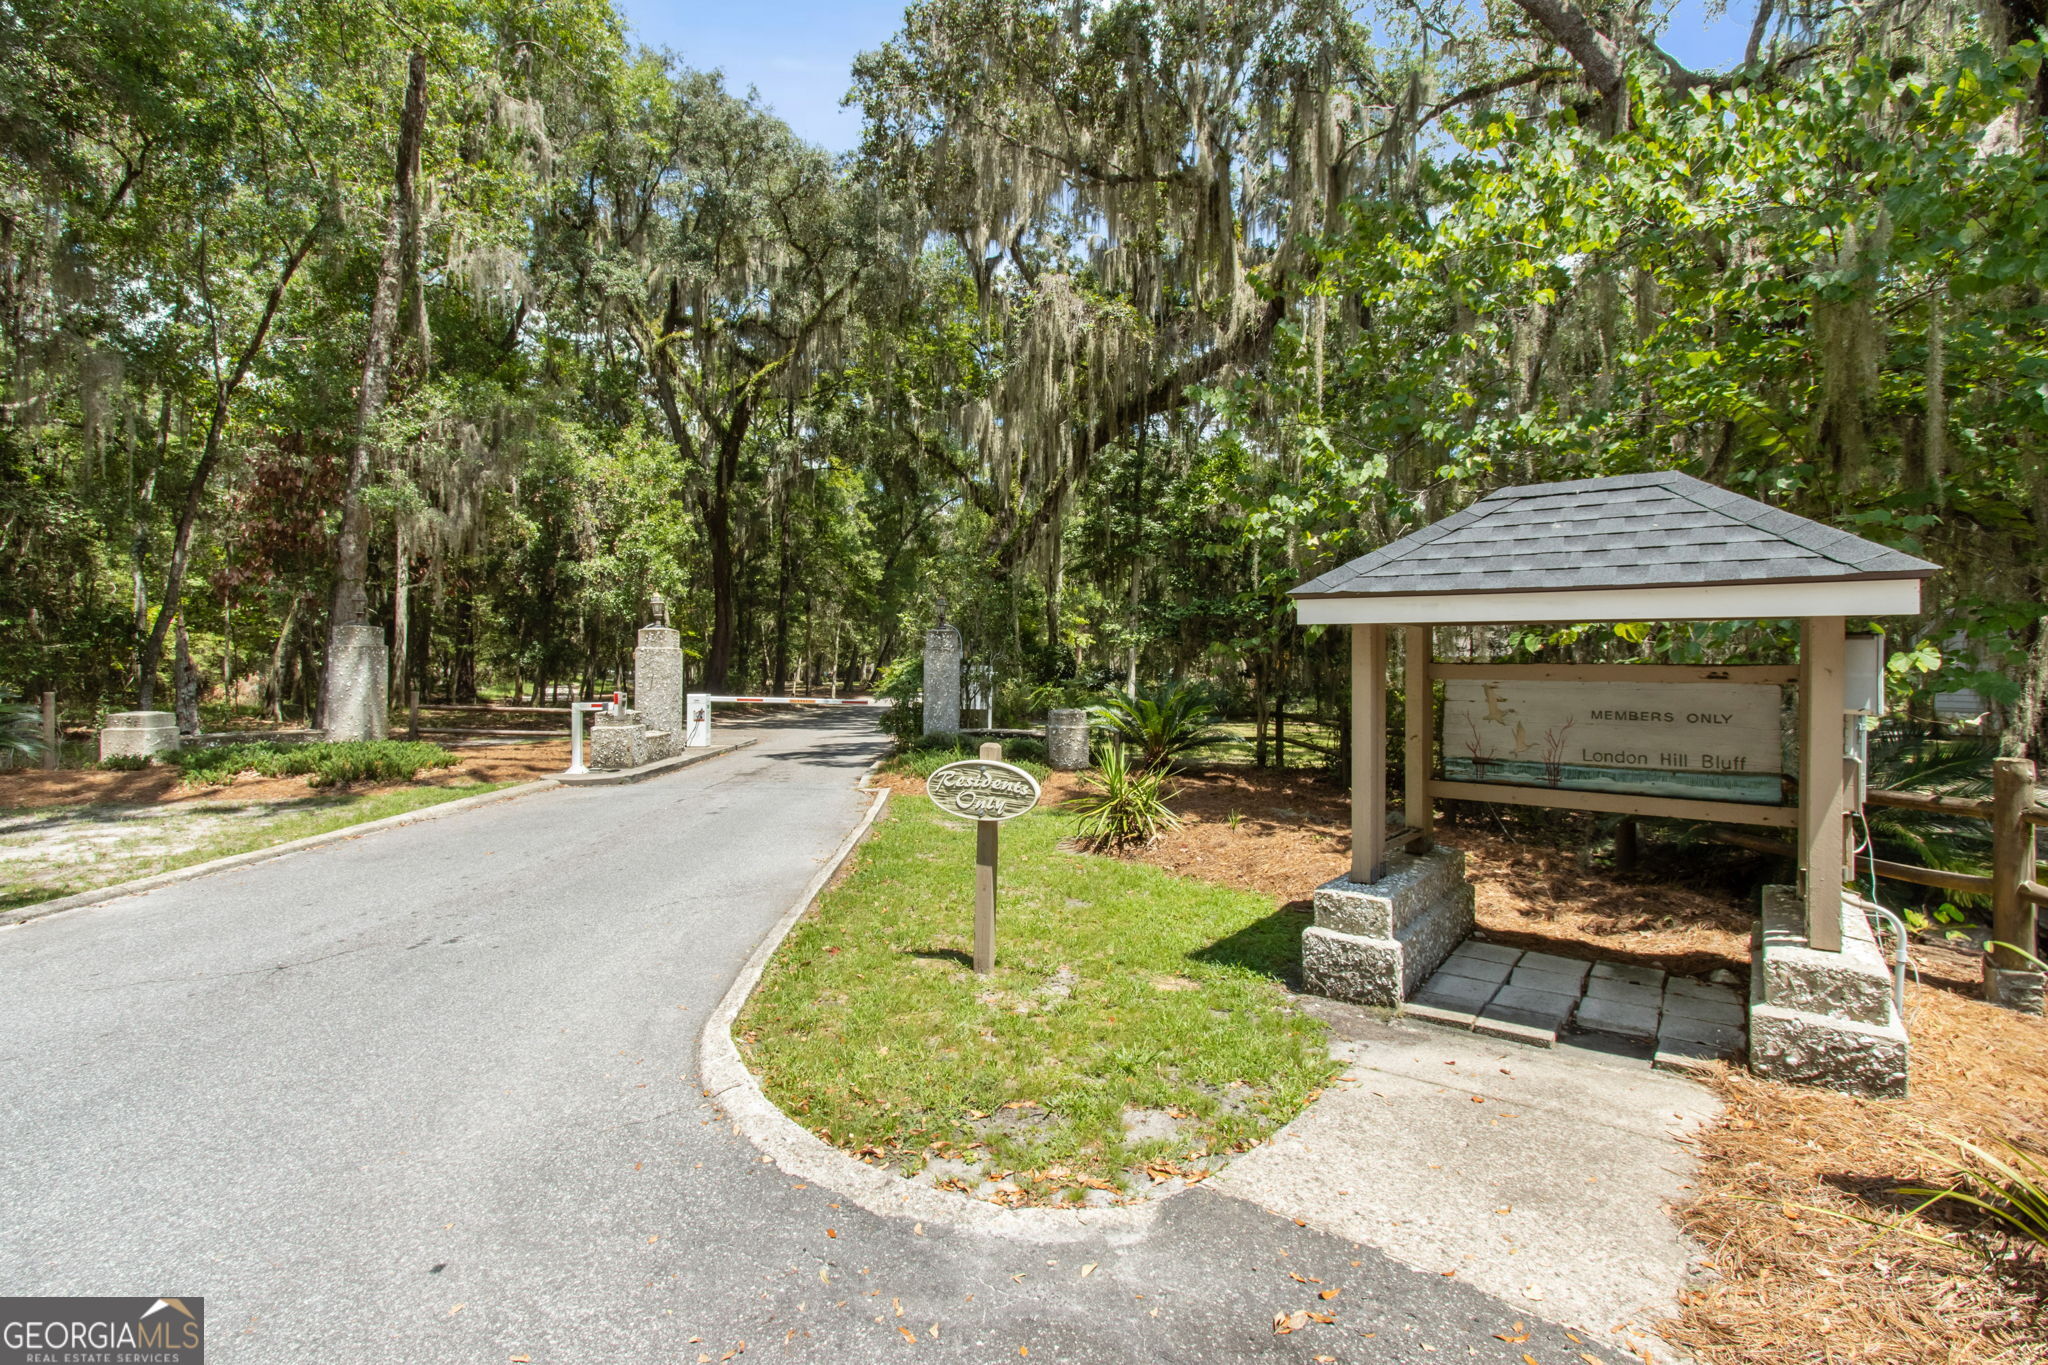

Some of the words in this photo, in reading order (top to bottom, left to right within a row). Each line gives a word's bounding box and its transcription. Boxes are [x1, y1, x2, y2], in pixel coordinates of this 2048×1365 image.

[1591, 710, 1674, 723] MEMBERS
[1686, 713, 1733, 724] ONLY
[1582, 749, 1648, 765] London
[1660, 752, 1688, 767] Hill
[1702, 754, 1747, 770] Bluff
[935, 770, 1029, 796] Residents
[956, 791, 1007, 815] Only
